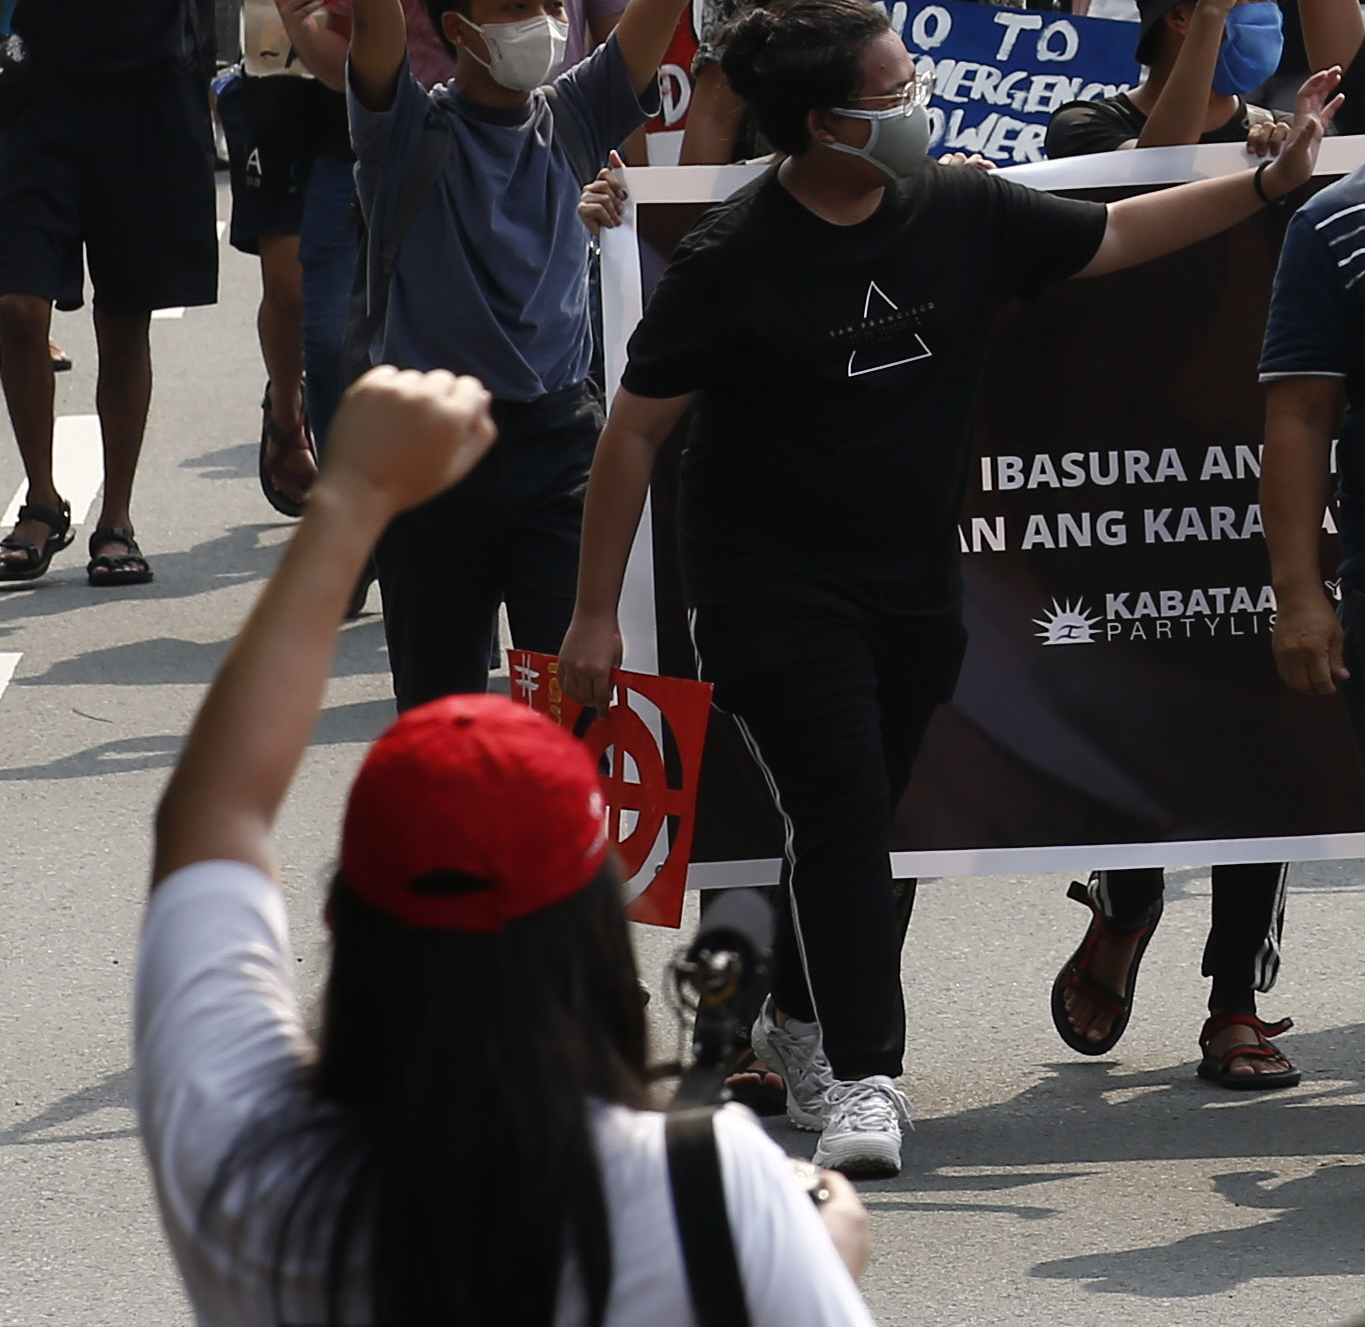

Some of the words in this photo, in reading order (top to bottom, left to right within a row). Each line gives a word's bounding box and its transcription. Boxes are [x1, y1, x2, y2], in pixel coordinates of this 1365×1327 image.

[994, 10, 1080, 62] TO
[829, 326, 853, 338] SAN
[980, 447, 1188, 493] IBASURA
[1200, 442, 1264, 482] AN
[1021, 509, 1128, 551] ANG
[1105, 585, 1278, 621] KABATAA
[1106, 614, 1278, 643] PARTYLIS
